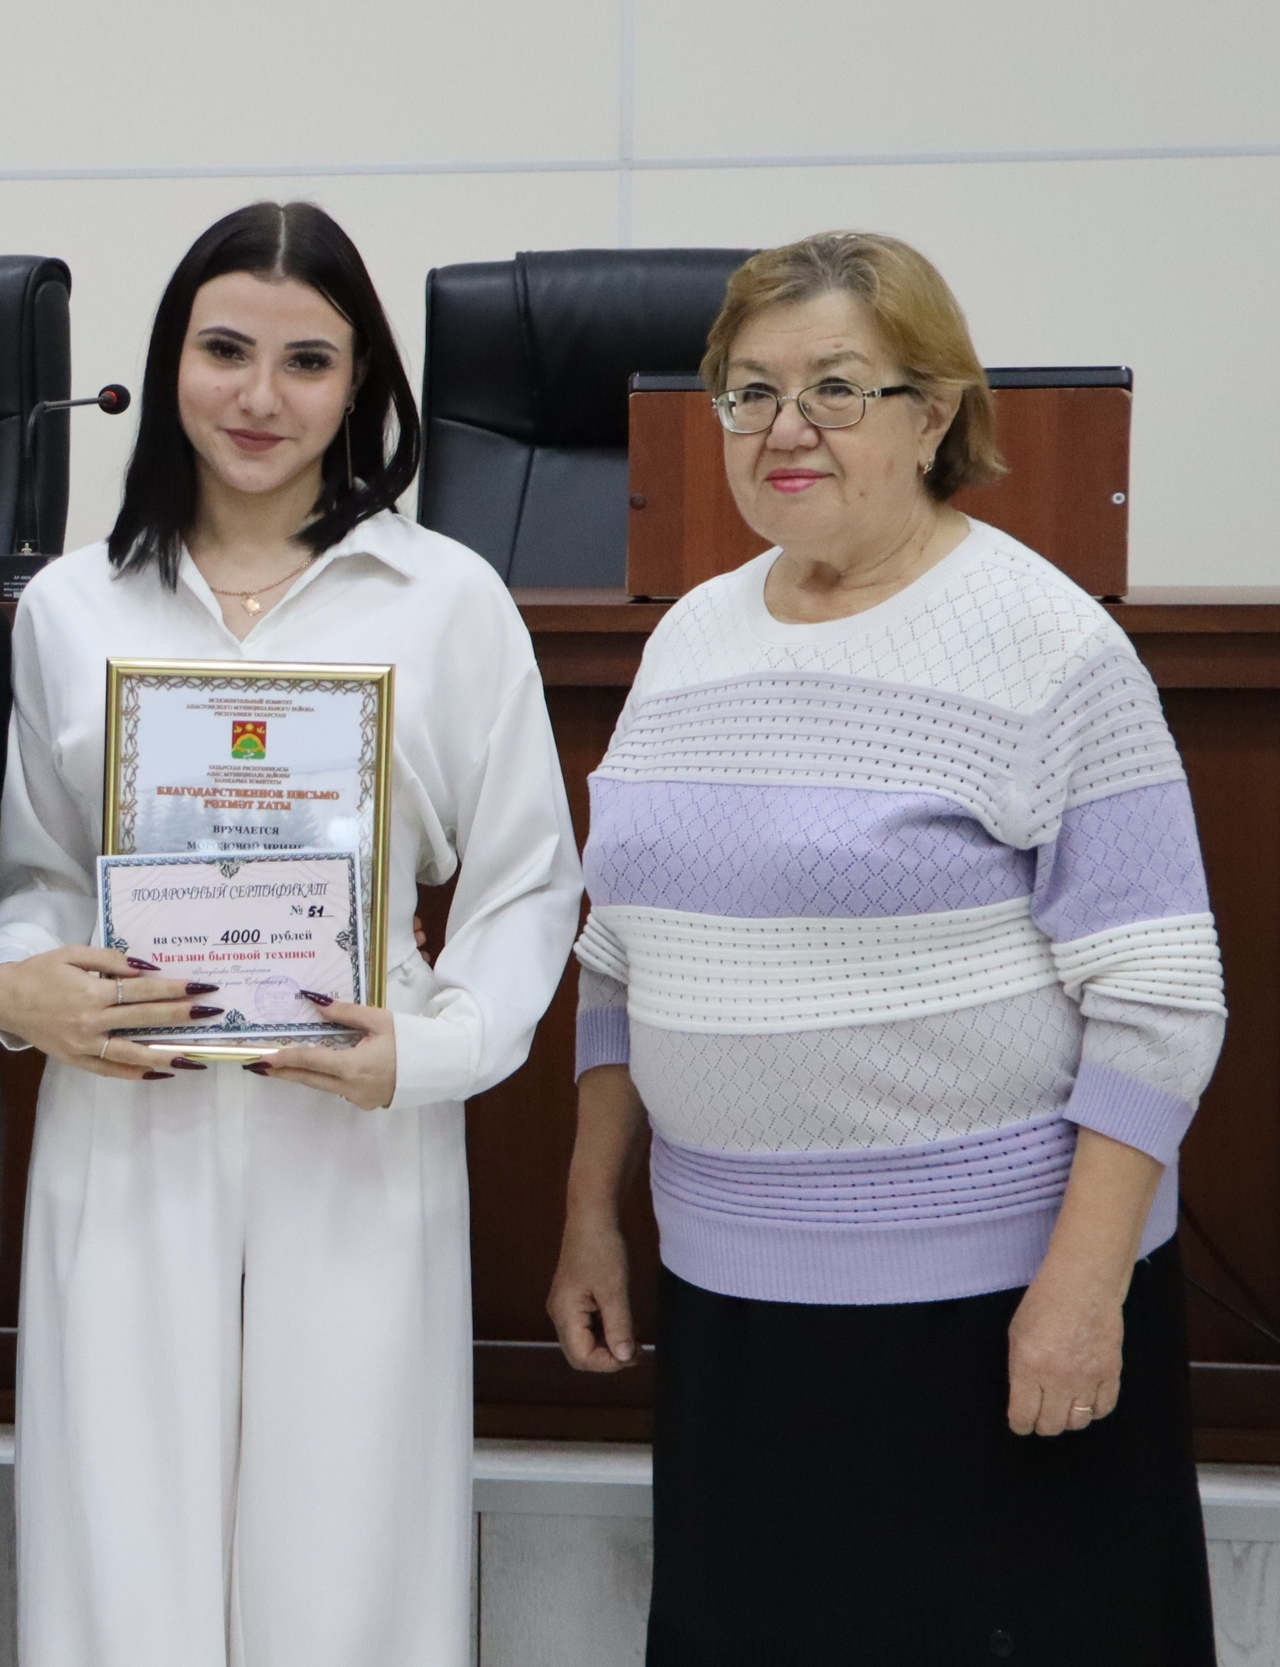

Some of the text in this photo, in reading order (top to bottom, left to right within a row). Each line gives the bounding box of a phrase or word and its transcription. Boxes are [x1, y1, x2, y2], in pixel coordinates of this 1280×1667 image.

[157, 785, 340, 801] БЛАГОДАРСТВЕННОЕ ПИСЬМО
[257, 800, 292, 811] ХАТЫ
[213, 824, 280, 835] ВРУЧАЕТСЯ
[132, 882, 329, 902] ПОДАРОЧНЫЙ СЕРТИФИКАТ
[308, 905, 325, 918] 51
[153, 928, 313, 947] на сумму 4000 рублей
[151, 950, 316, 963] Магазин бытовой техники
